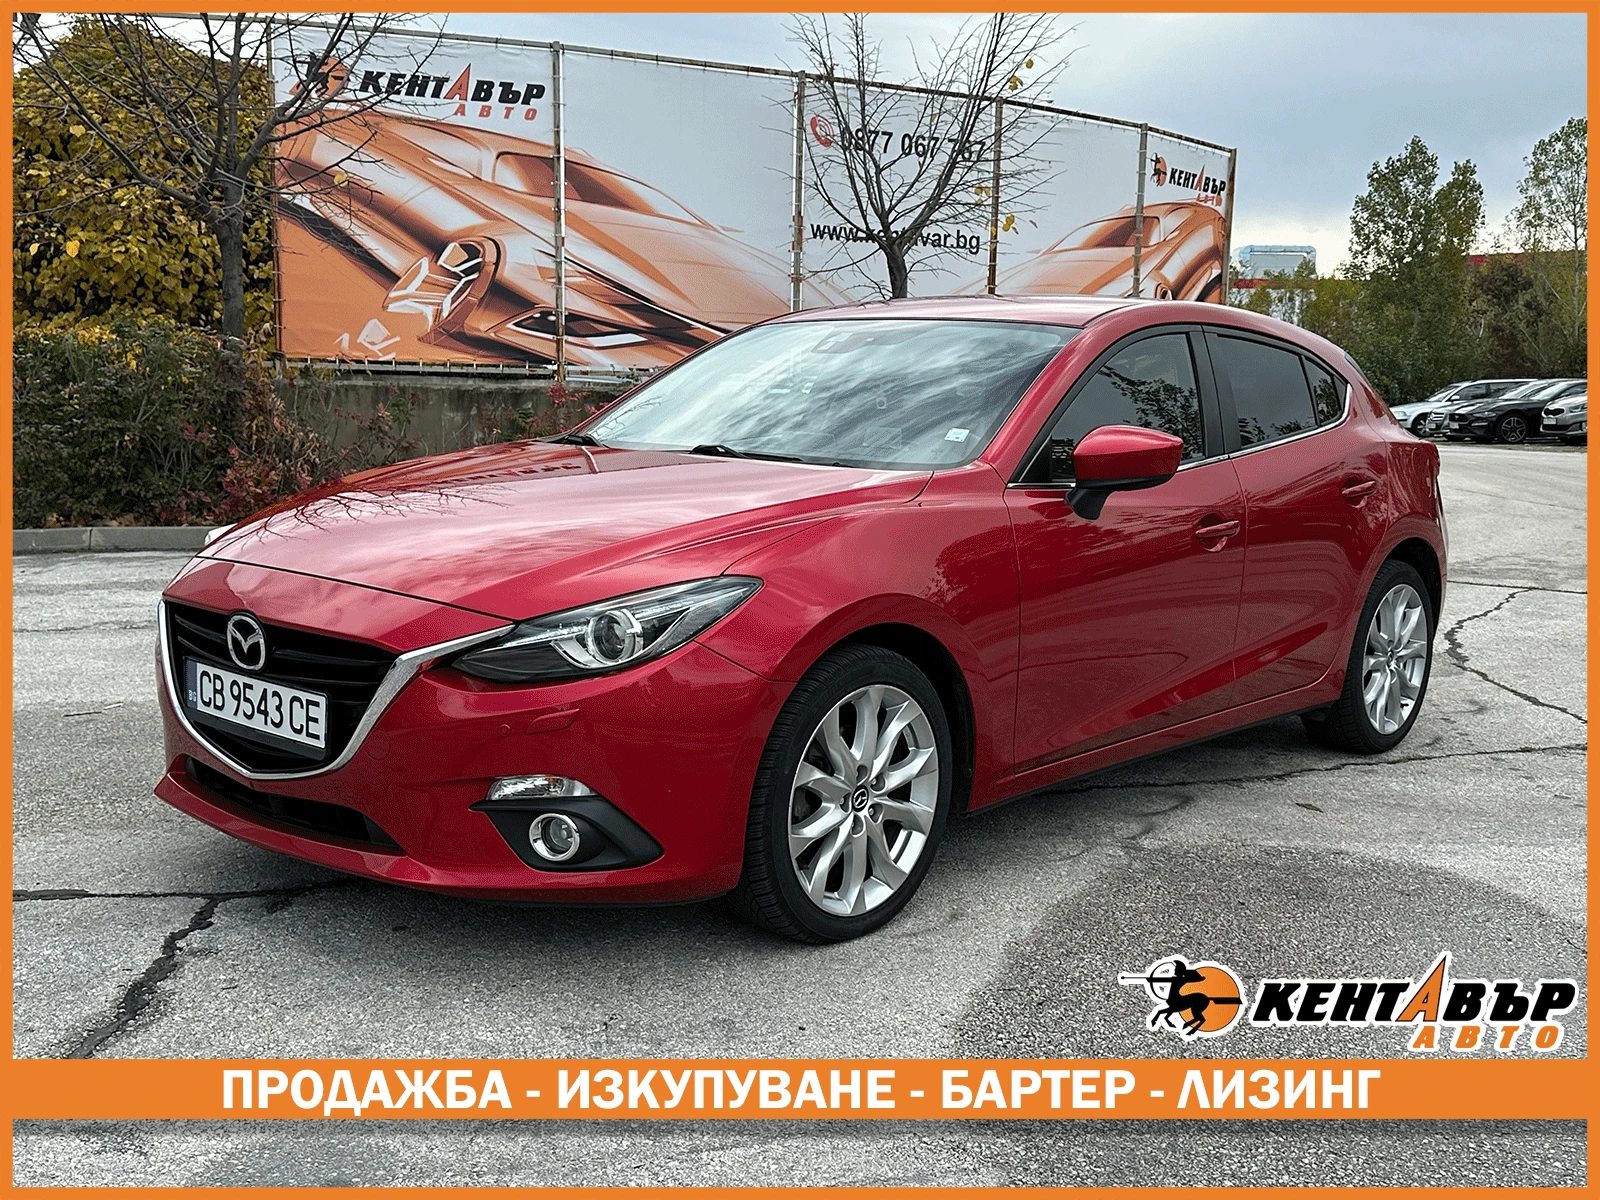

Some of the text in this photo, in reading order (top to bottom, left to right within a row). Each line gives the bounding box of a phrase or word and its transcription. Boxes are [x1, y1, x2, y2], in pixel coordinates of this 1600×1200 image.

[359, 63, 546, 106] КЕНТАВЪР
[453, 103, 538, 121] АВТО
[901, 133, 940, 158] 067
[1169, 164, 1227, 195] КЕНТАВЪР
[229, 679, 284, 729] 9543
